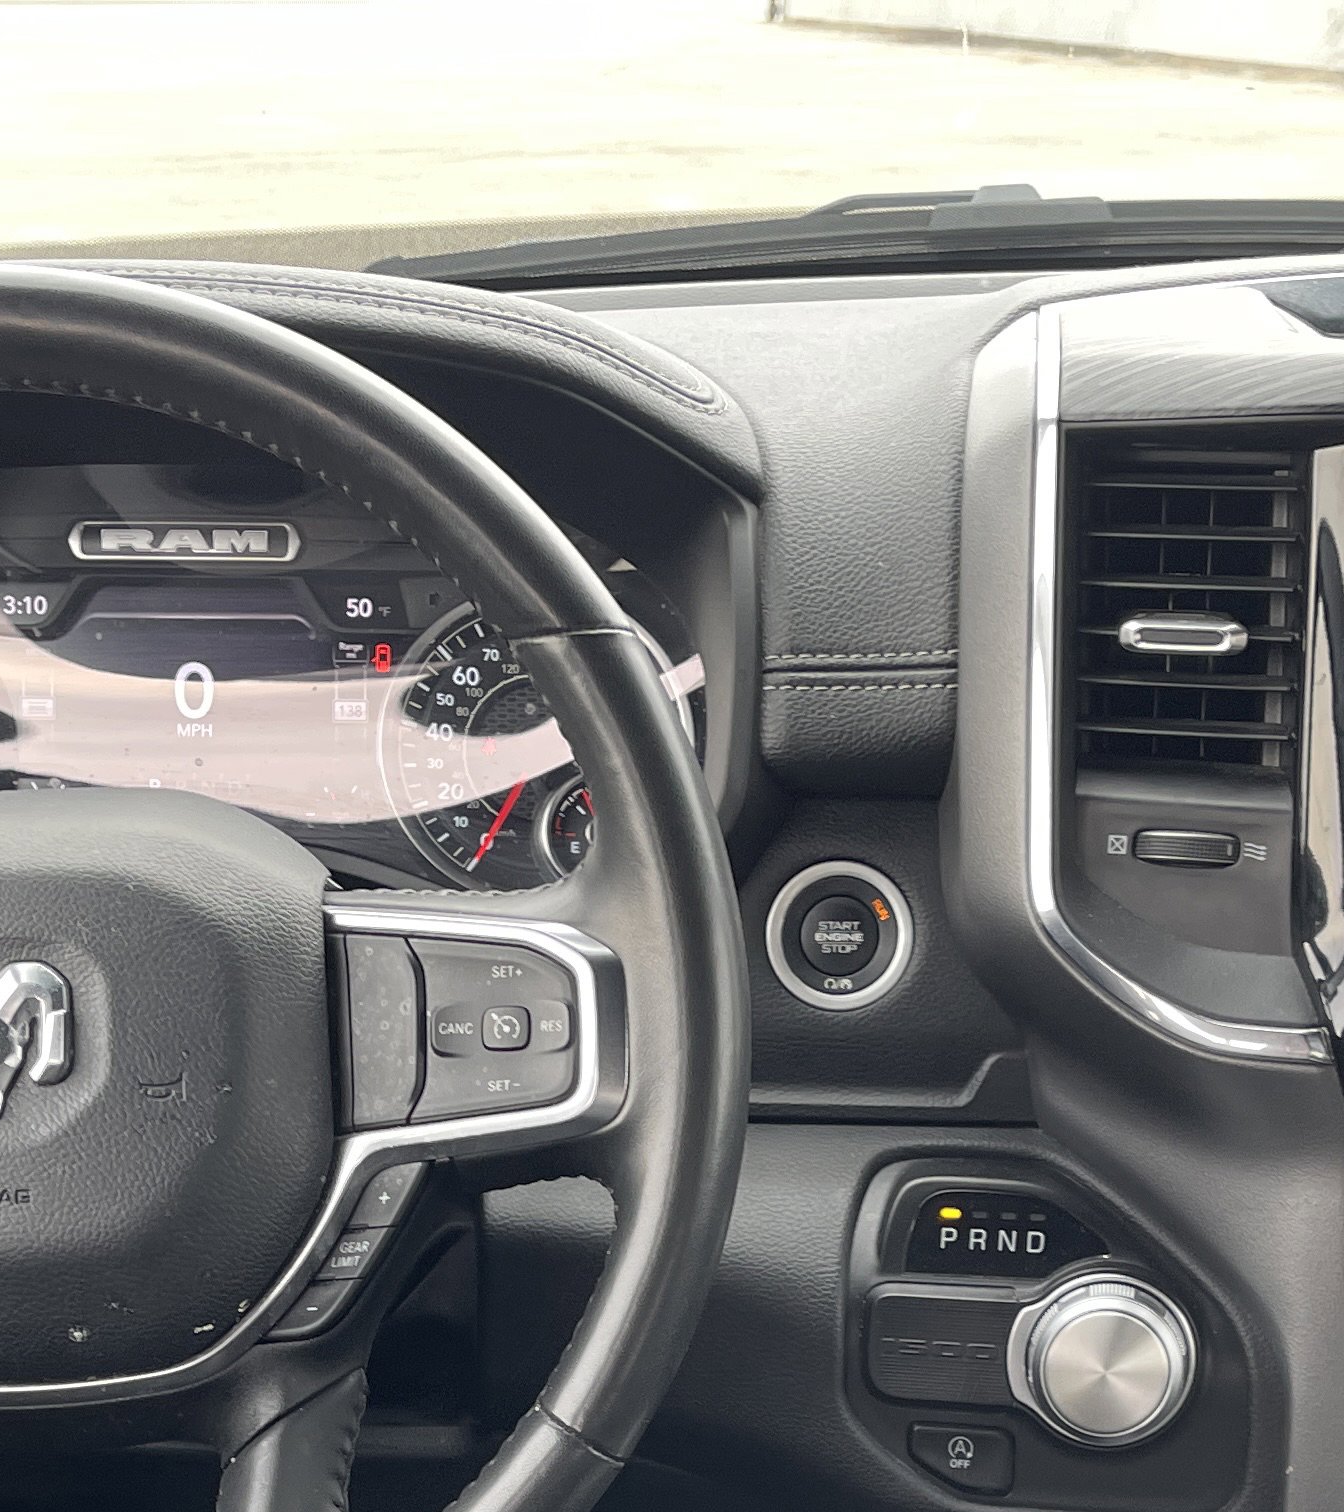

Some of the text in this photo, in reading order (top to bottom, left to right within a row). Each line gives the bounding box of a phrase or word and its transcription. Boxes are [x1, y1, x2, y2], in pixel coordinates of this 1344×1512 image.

[99, 528, 269, 555] RAM
[3, 595, 48, 615] 3:10
[346, 598, 373, 618] 50
[482, 648, 502, 662] 70
[452, 666, 480, 686] 60
[174, 661, 215, 719] 0
[436, 692, 455, 707] 50
[177, 723, 213, 737] MPH
[425, 723, 454, 742] 40
[427, 758, 443, 769] 30
[438, 782, 464, 800] 20
[453, 816, 469, 828] 10
[570, 841, 581, 854] E
[818, 921, 861, 931] START
[814, 932, 864, 942] ENGINE
[821, 944, 858, 954] STOP
[438, 1022, 474, 1035] CANC
[539, 1020, 563, 1032] RES
[339, 1240, 370, 1254] GEAR
[939, 1227, 1046, 1254] P R N D
[330, 1255, 362, 1268] LIMIT
[950, 1459, 971, 1469] OFF
